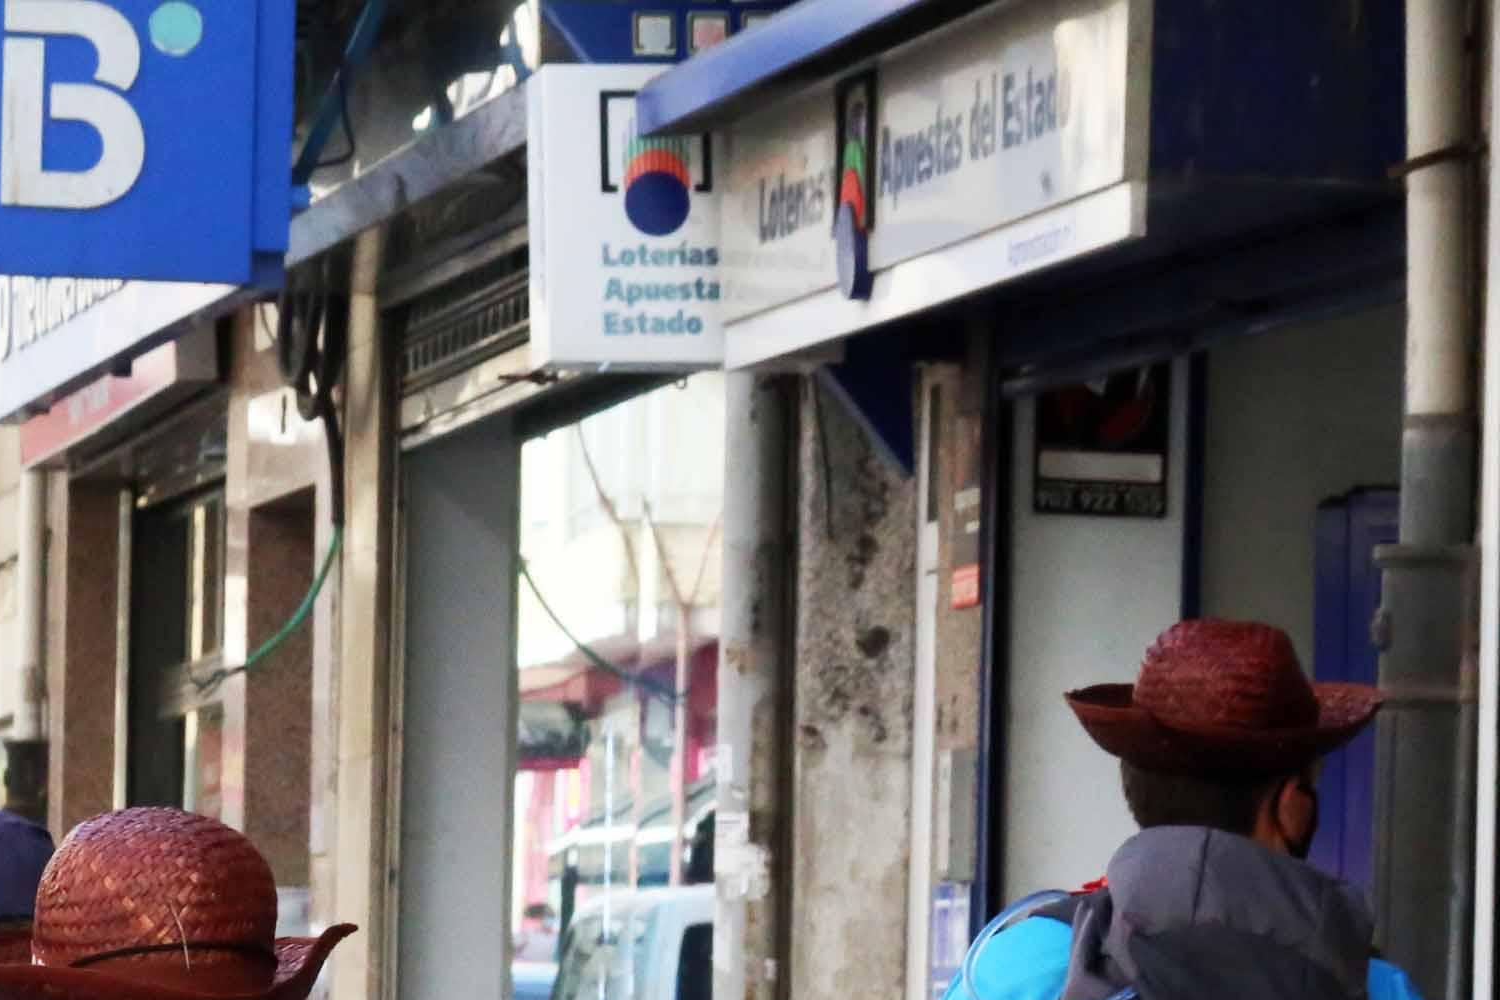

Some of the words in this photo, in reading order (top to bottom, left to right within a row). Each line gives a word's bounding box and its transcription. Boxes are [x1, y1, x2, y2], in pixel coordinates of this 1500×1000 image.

[0, 0, 145, 209] B
[878, 103, 965, 210] Apuestas
[970, 70, 997, 160] del
[602, 241, 719, 266] Loterías
[603, 310, 703, 335] Estado
